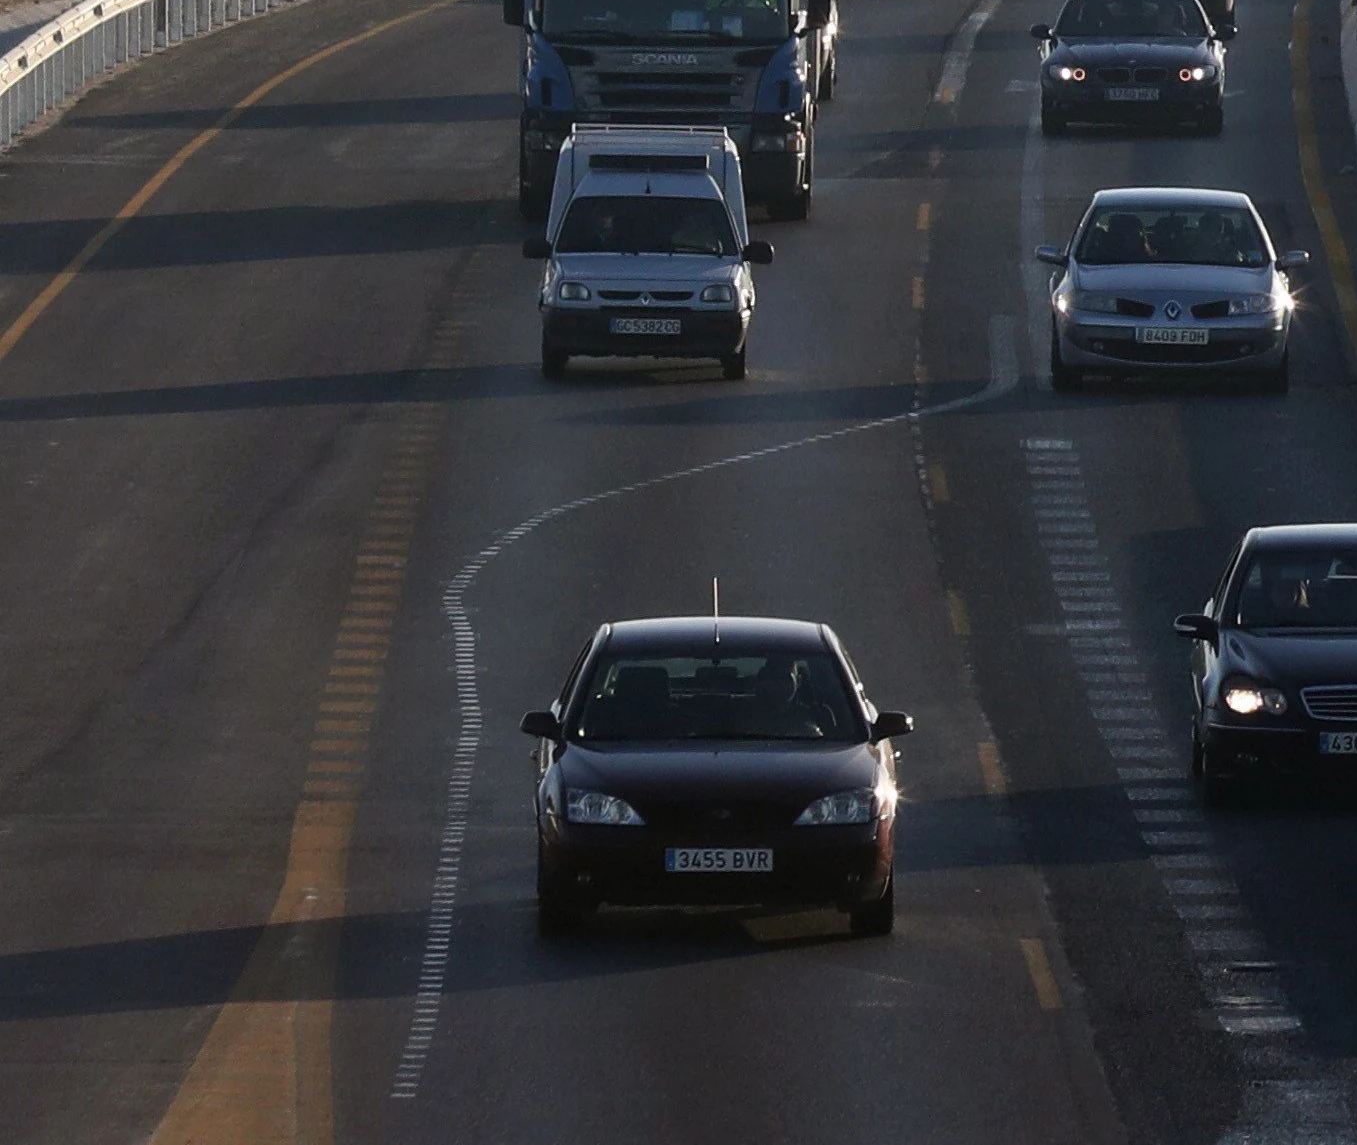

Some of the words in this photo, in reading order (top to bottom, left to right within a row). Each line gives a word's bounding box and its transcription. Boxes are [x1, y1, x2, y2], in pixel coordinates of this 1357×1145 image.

[631, 52, 698, 66] SCANIA
[1145, 329, 1177, 343] 8409
[679, 850, 727, 870] 3455
[732, 850, 769, 869] BVR
